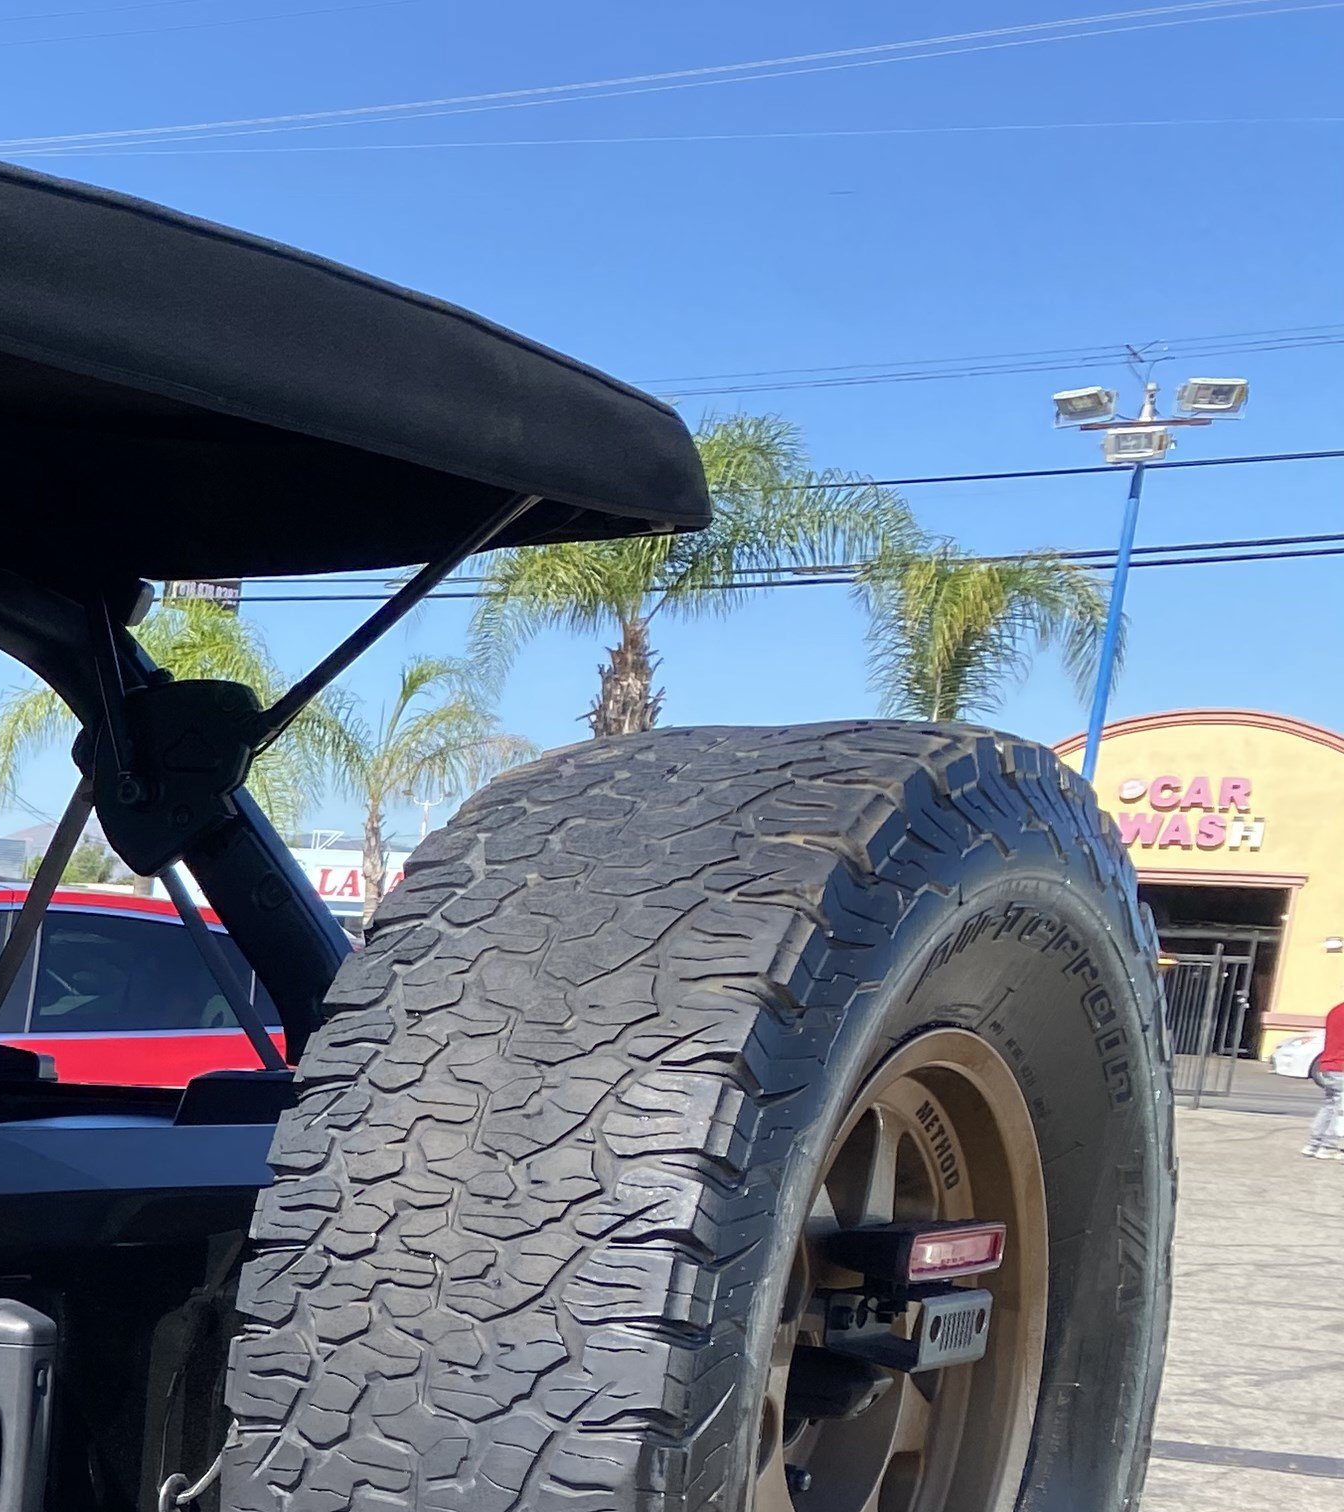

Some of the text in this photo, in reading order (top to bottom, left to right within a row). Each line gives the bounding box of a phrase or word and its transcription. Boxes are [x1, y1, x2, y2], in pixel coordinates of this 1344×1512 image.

[1150, 776, 1253, 814] CAR
[1119, 812, 1266, 853] WASH
[915, 1100, 961, 1190] METHOD
